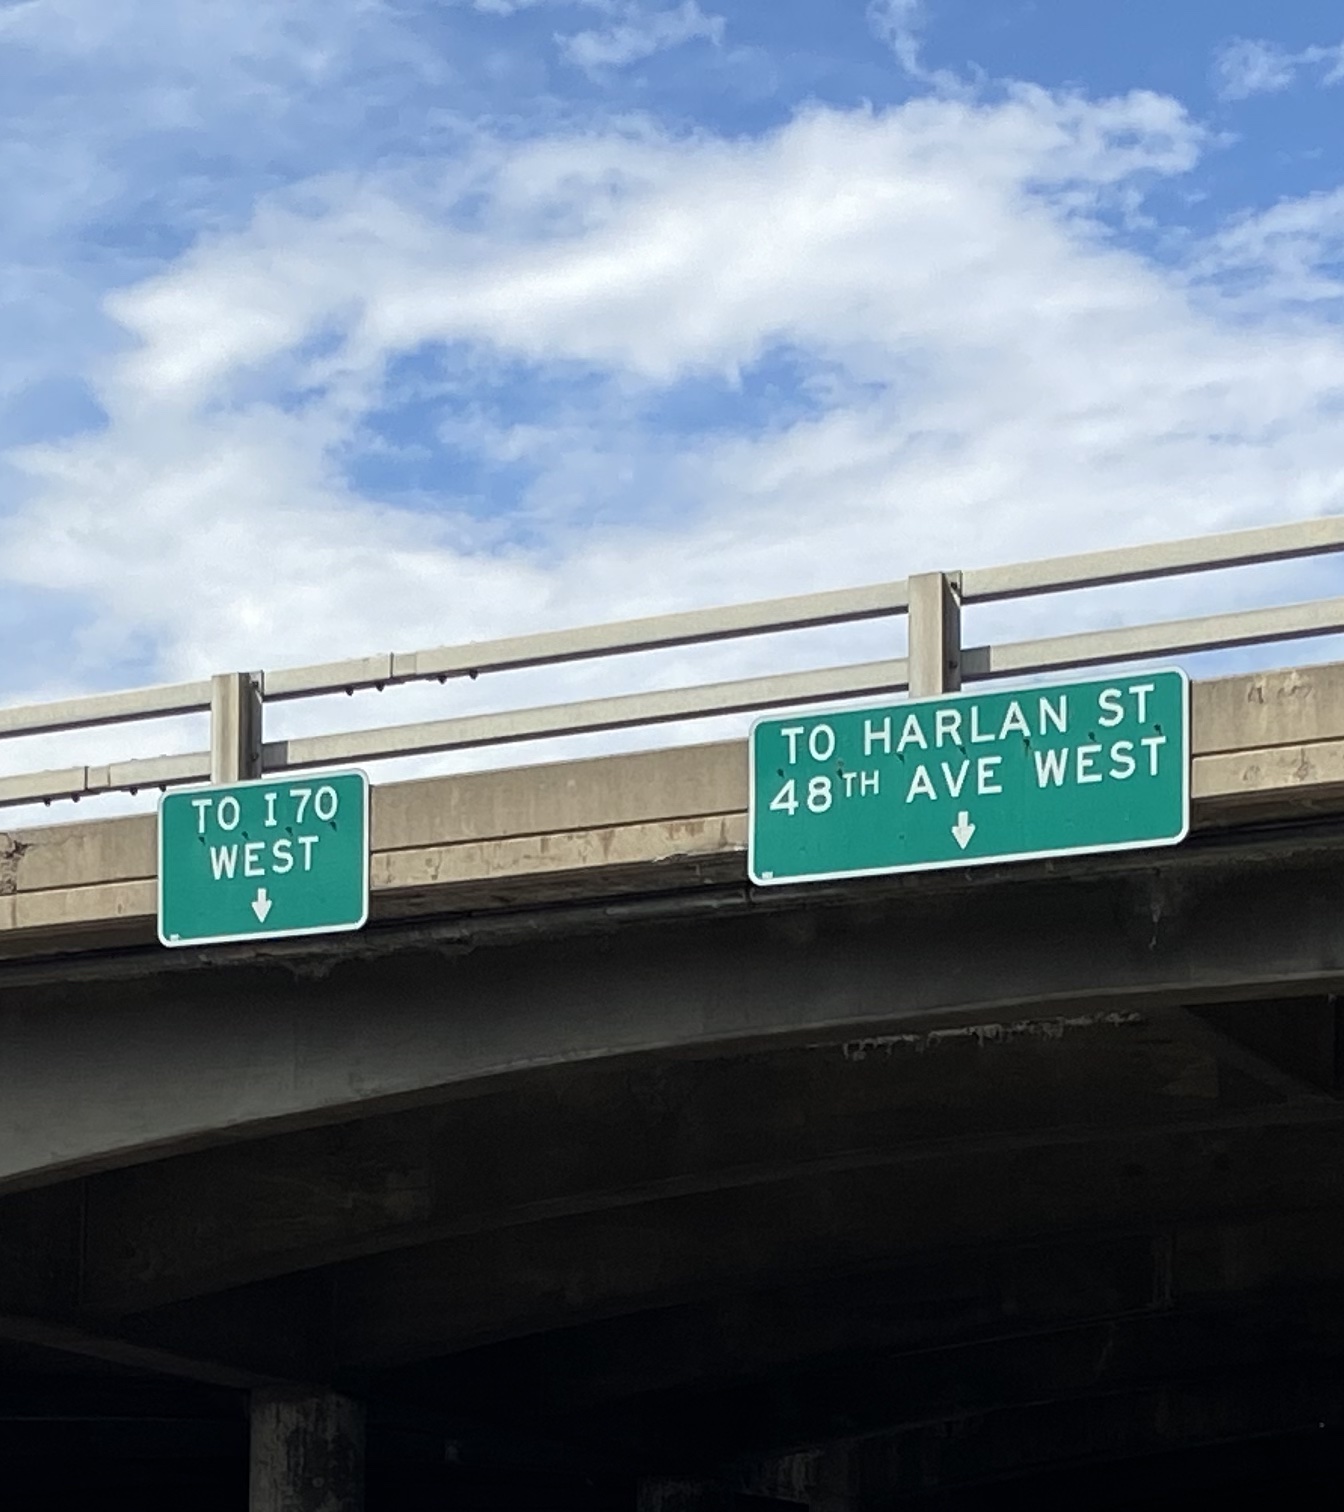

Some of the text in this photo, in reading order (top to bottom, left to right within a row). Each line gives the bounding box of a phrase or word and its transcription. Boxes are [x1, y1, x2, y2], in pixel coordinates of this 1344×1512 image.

[780, 684, 1155, 764] TO HARLAN ST
[769, 735, 1167, 815] 48TH AVE WEST
[191, 796, 241, 834] TO
[209, 835, 320, 881] WEST
